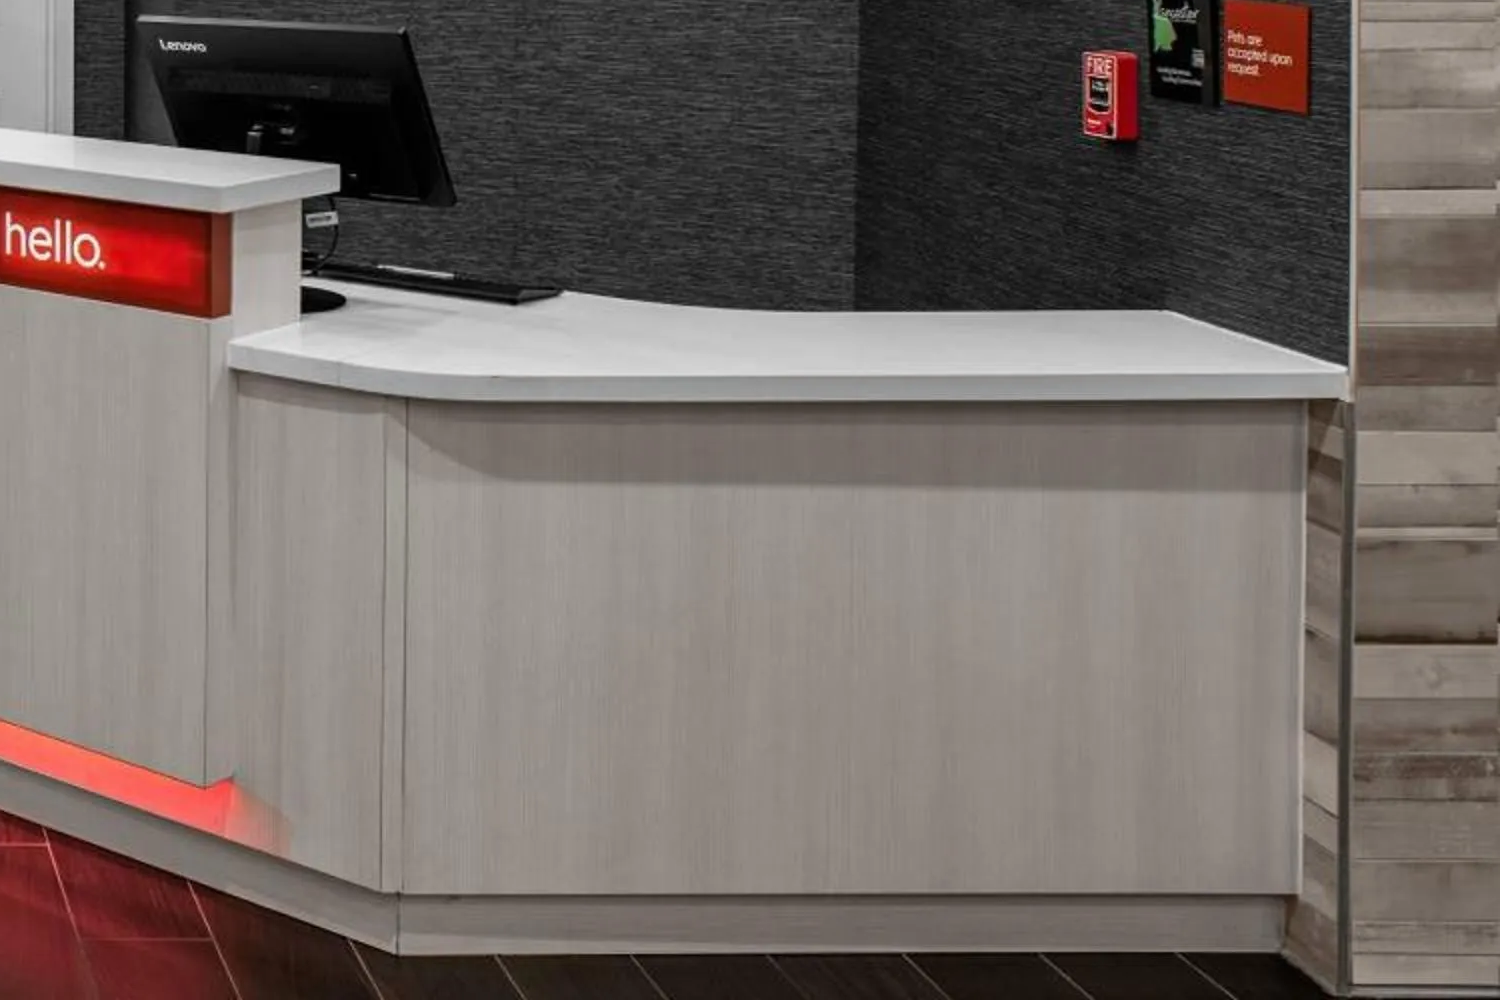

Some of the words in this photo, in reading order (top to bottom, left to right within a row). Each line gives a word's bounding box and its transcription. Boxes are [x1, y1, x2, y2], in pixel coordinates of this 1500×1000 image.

[159, 38, 207, 53] Lenovo
[1227, 29, 1245, 45] Pets
[1247, 35, 1263, 47] are
[1087, 55, 1113, 75] FIRE
[1227, 48, 1268, 63] accepted
[1269, 54, 1293, 67] upon
[4, 210, 106, 271] hello.
